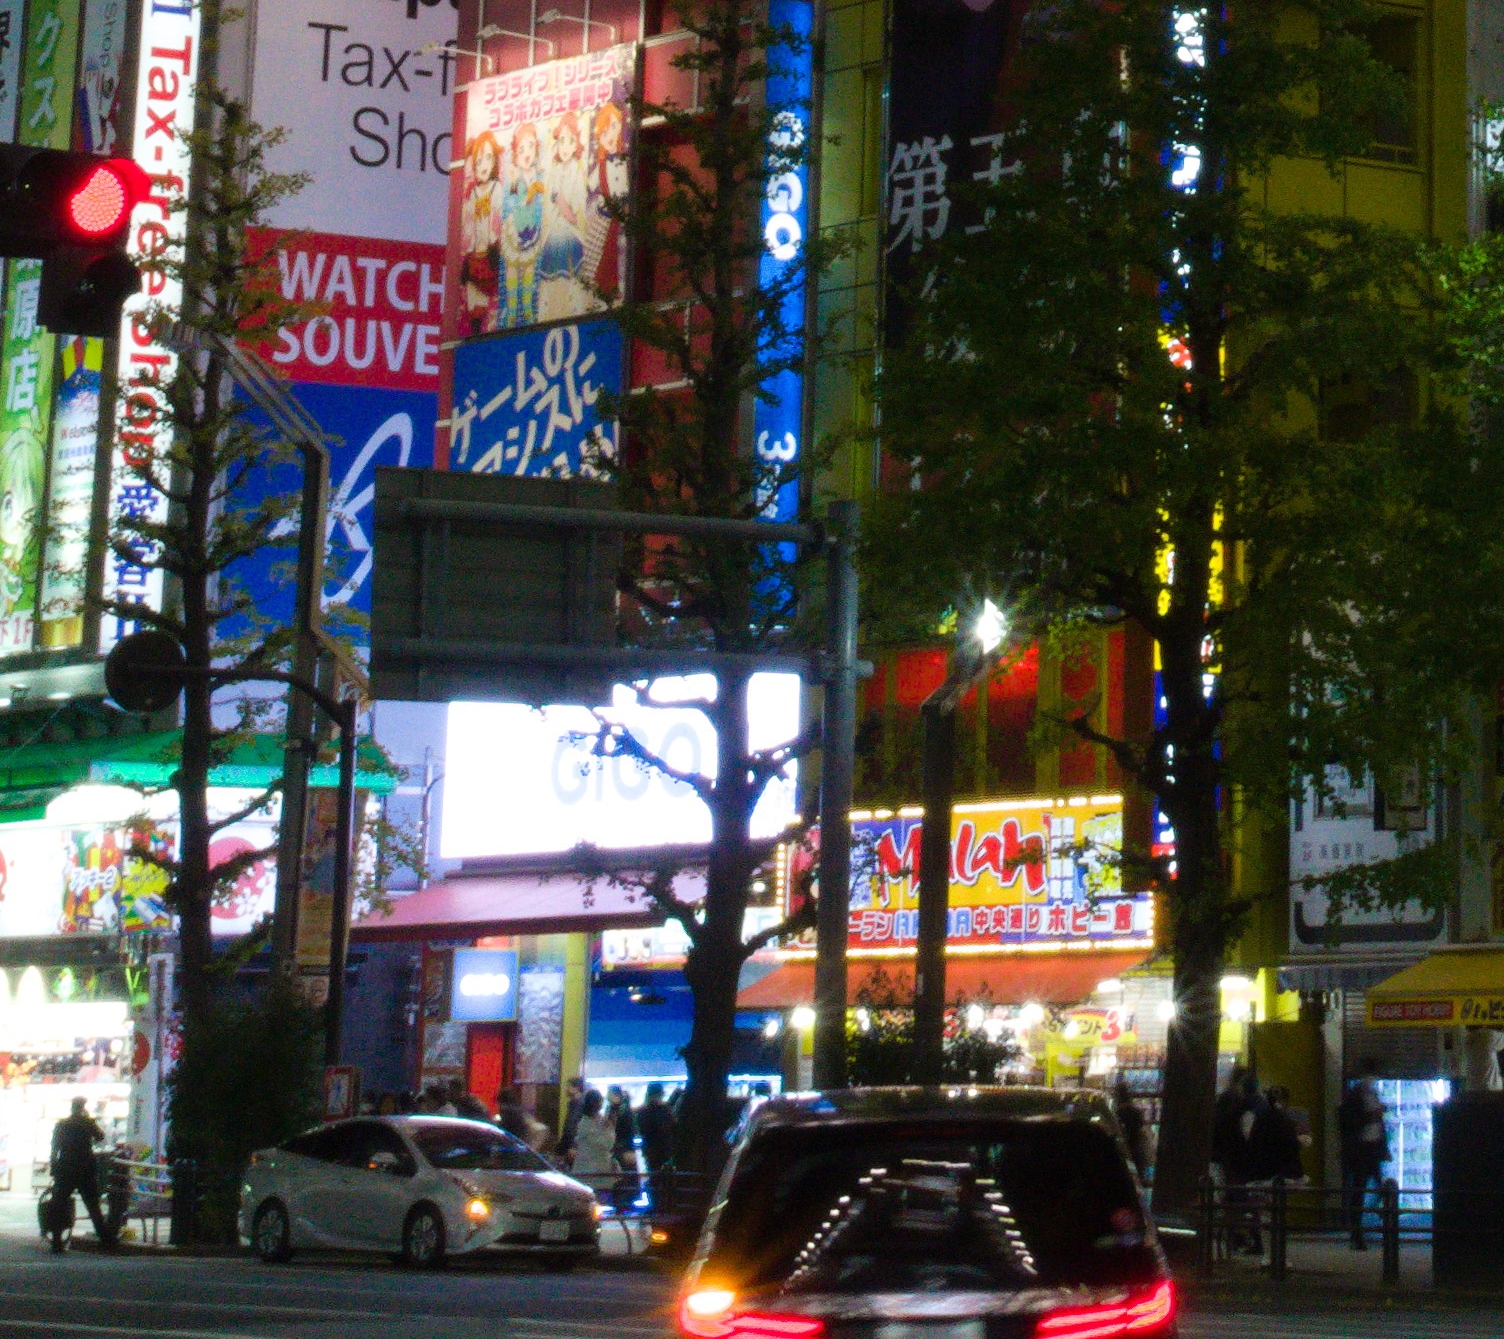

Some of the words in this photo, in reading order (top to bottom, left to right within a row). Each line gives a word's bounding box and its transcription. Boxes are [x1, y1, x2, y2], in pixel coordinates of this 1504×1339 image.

[100, 4, 115, 69] Shop
[484, 55, 620, 106] ラブライブ!シリーズ
[763, 109, 805, 261] GGO
[275, 251, 447, 315] WATCH
[450, 325, 580, 464] ゲームの
[877, 817, 1048, 907] Mlan
